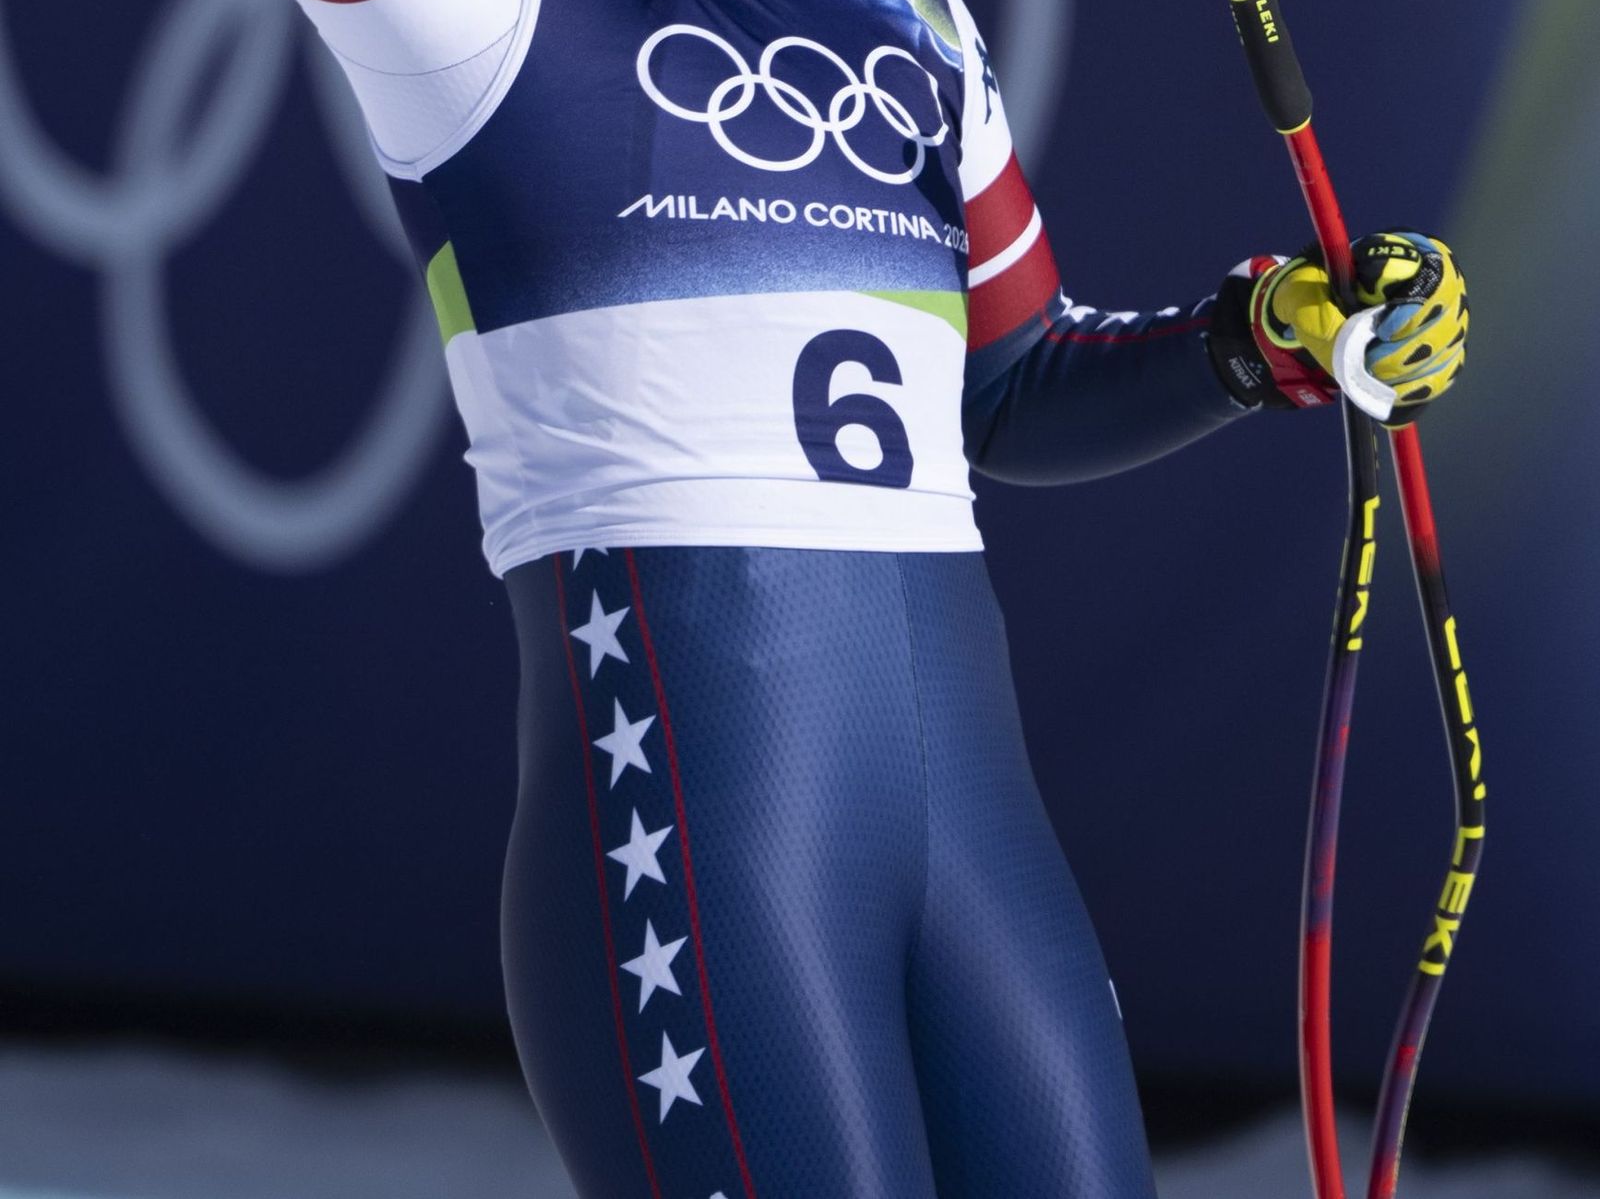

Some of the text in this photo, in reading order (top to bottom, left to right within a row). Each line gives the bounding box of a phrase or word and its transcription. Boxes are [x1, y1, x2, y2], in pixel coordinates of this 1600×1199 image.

[617, 194, 797, 224] MILANO
[803, 202, 942, 244] CORTINA
[1367, 245, 1419, 259] LEKI
[792, 328, 914, 489] 6
[1418, 825, 1486, 977] LEKI
